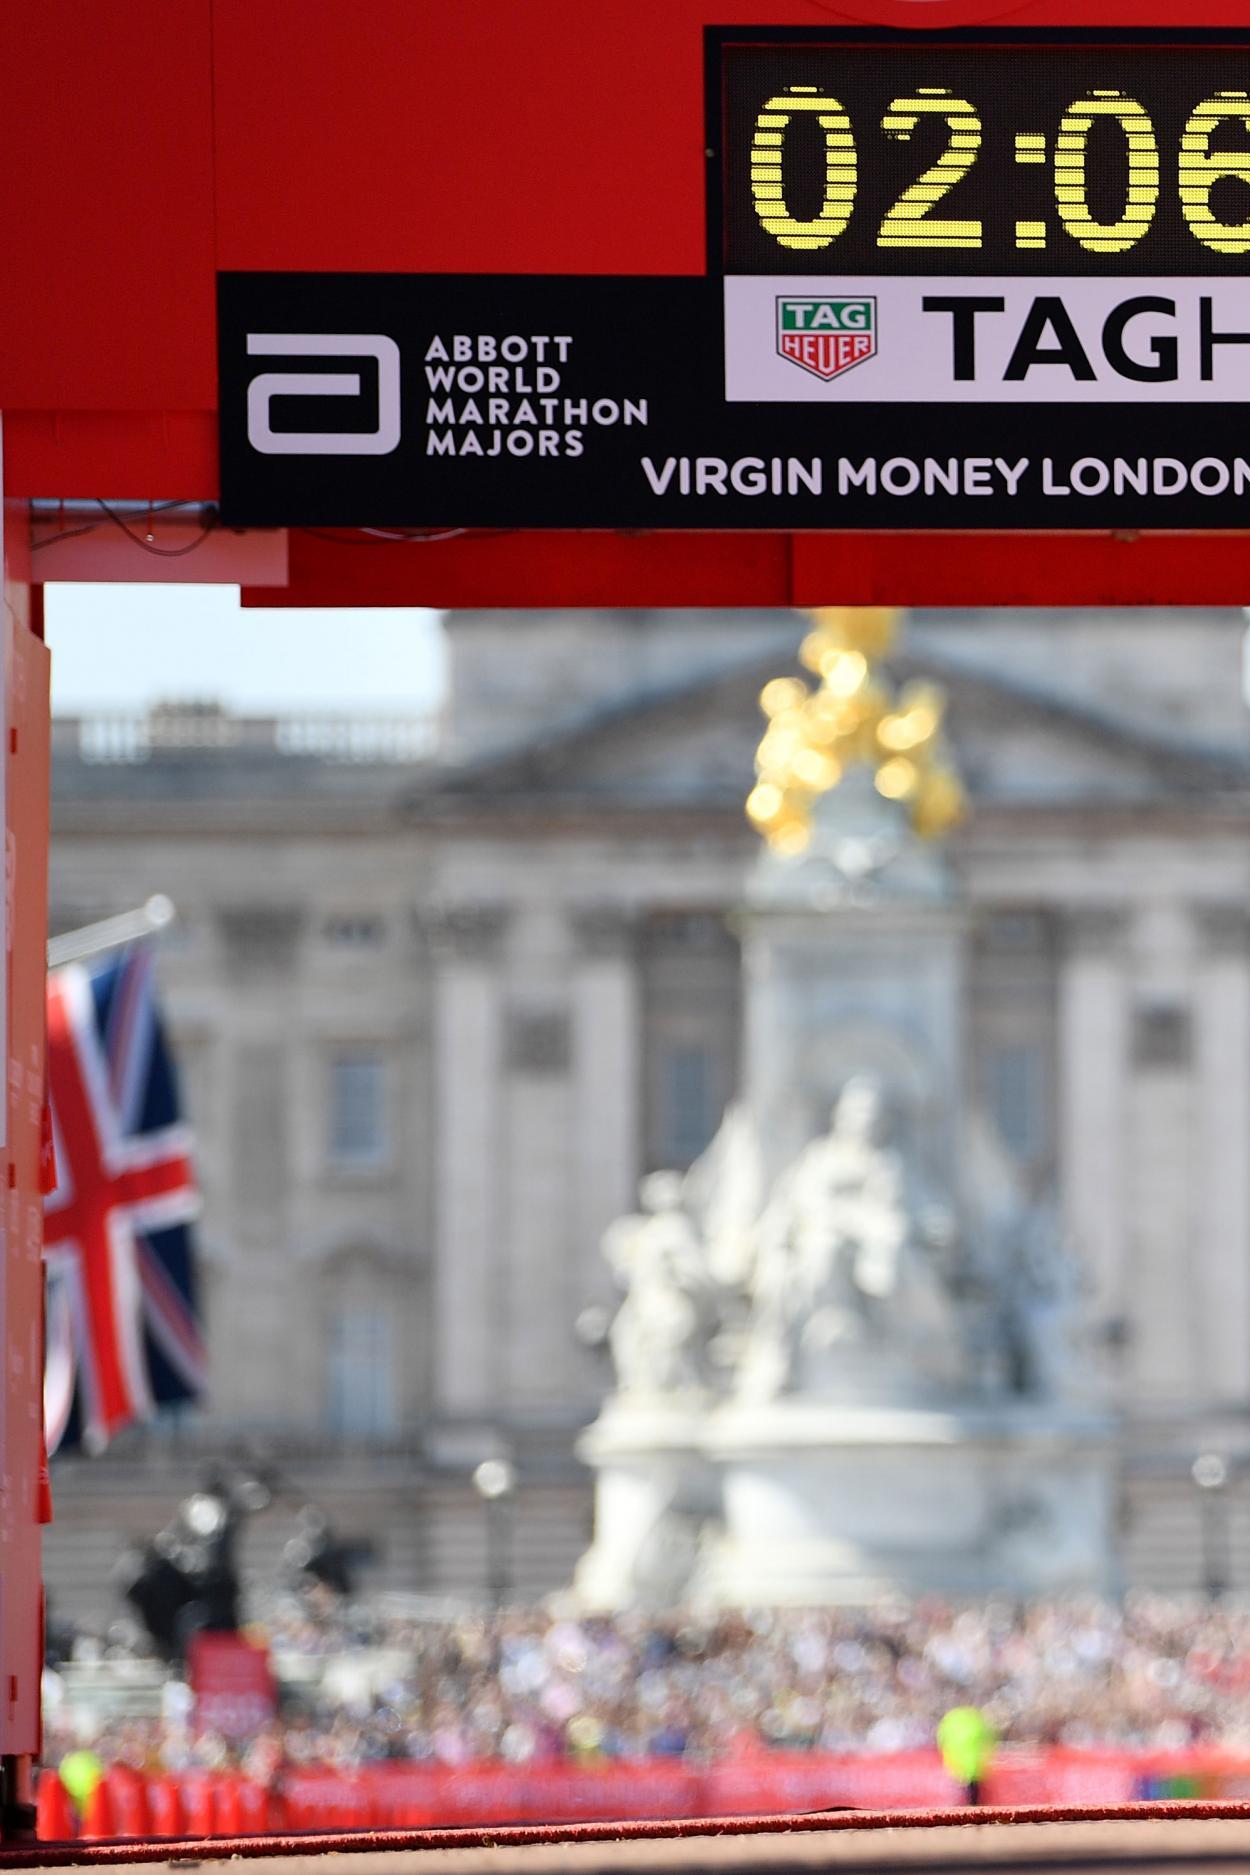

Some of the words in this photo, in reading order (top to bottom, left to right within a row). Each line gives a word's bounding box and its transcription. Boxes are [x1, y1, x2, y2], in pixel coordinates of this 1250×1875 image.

[786, 304, 867, 328] TAG
[425, 335, 573, 363] ABBOTT
[784, 336, 870, 373] HEUER
[425, 366, 560, 393] WORLD
[426, 398, 648, 426] MARATHON
[426, 429, 584, 457] MAJORS
[641, 456, 822, 496] VIRGIN
[838, 457, 1029, 496] MONEY
